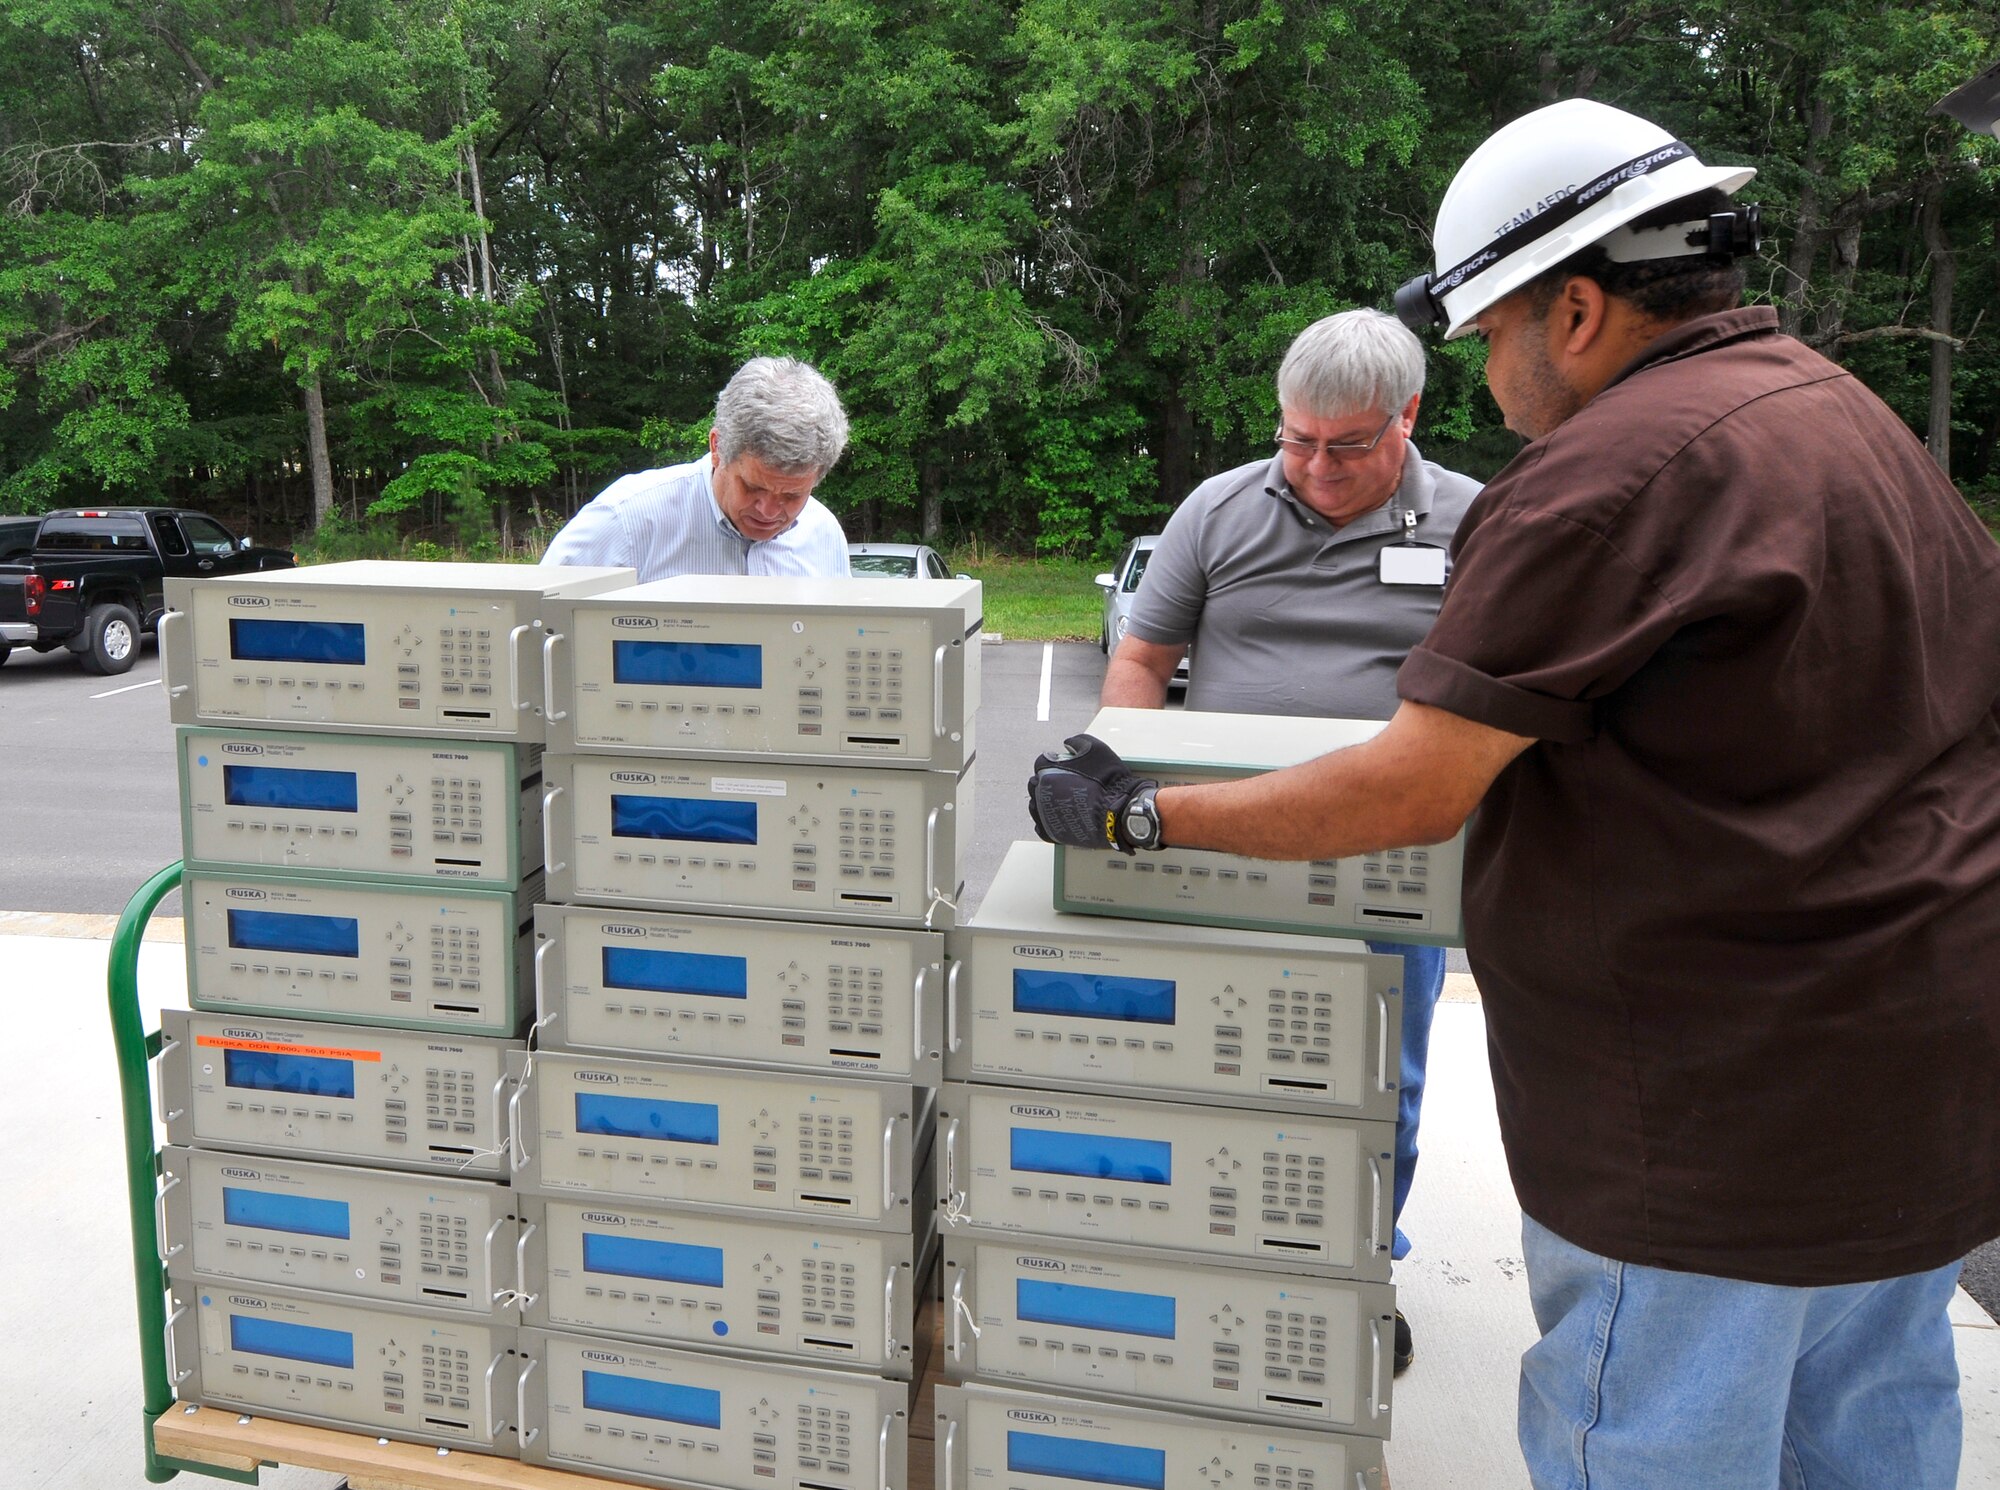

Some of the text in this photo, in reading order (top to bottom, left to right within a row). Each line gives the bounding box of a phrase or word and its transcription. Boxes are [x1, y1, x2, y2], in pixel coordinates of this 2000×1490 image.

[1577, 147, 1675, 204] NIGHTSTICK
[1494, 184, 1577, 237] TEAM AEDC
[233, 597, 265, 606] RUSKA
[617, 617, 653, 626] RUSKA
[226, 744, 259, 753] RUSKA
[432, 752, 453, 760] SERIES
[616, 773, 651, 782] RUSKA
[230, 889, 262, 898] RUSKA
[607, 925, 641, 935] RUSKA
[830, 939, 871, 949] SERIES 7000
[1019, 947, 1057, 957] RUSKA
[227, 1029, 258, 1039] RUSKA
[208, 1039, 244, 1047] RUSKA
[831, 1060, 879, 1070] MEMORY CARD
[579, 1072, 613, 1082] RUSKA
[1016, 1106, 1054, 1117] RUSKA
[226, 1168, 256, 1178] RUSKA
[587, 1213, 620, 1224] RUSKA
[1022, 1258, 1060, 1270] RUSKA
[233, 1296, 263, 1308] RUSKA
[587, 1351, 619, 1363] RUSKA
[1013, 1411, 1050, 1422] RUSKA
